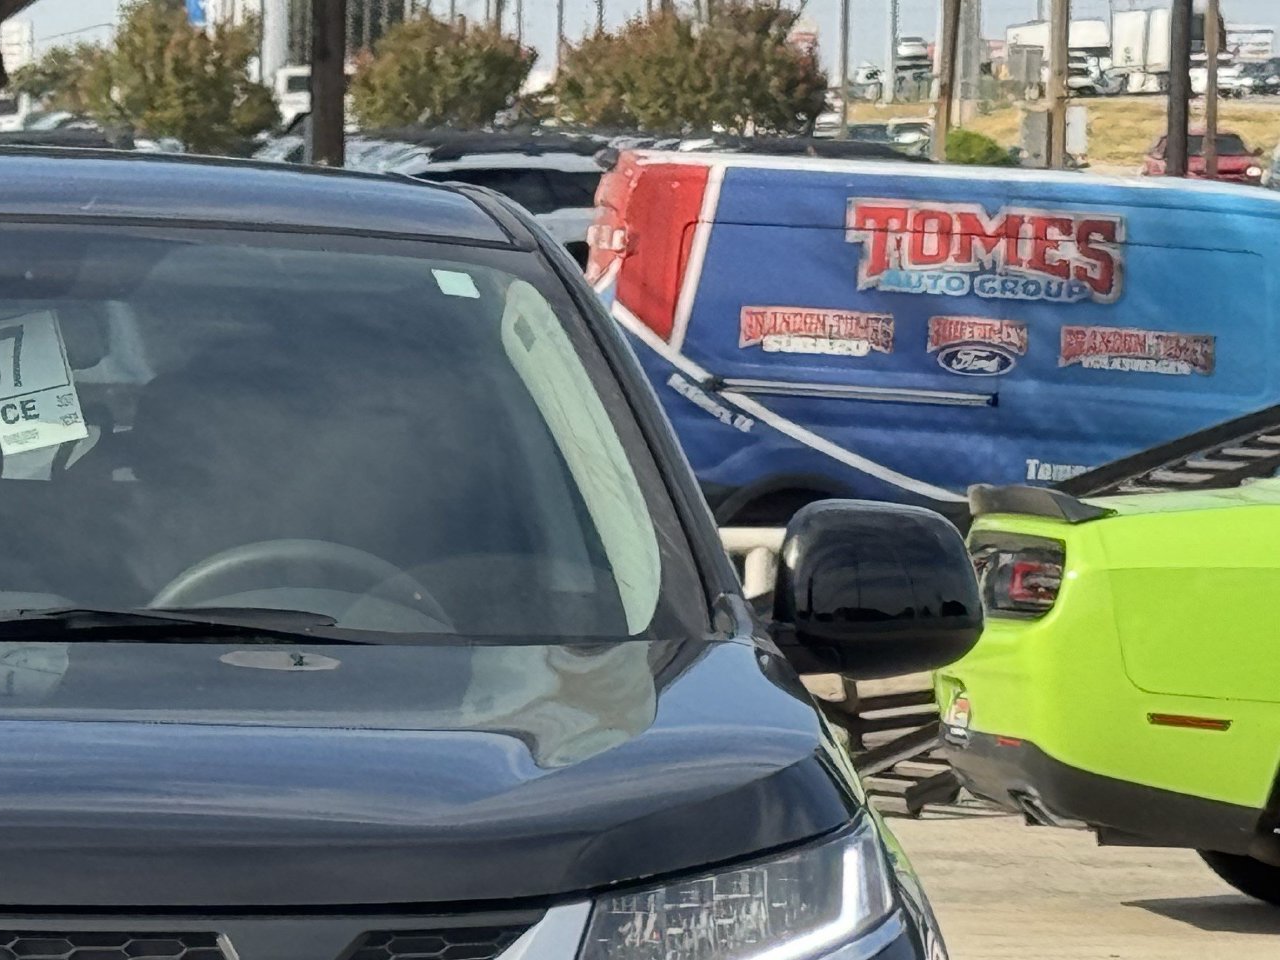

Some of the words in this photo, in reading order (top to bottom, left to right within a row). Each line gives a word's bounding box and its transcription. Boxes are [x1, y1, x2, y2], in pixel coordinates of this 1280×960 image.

[852, 203, 1120, 297] TOMES
[880, 270, 966, 291] AUTO
[974, 276, 1090, 300] GROUP
